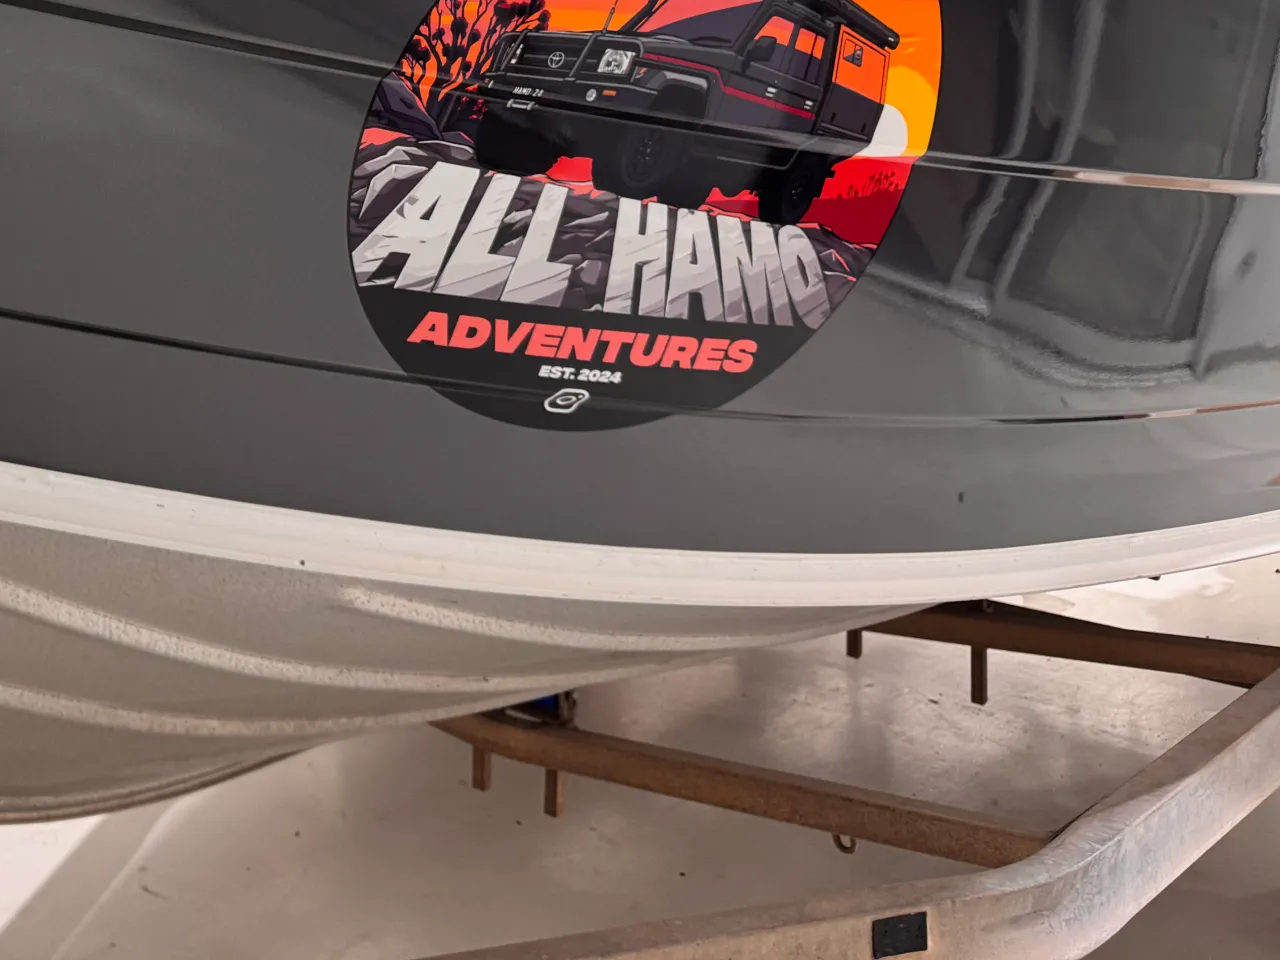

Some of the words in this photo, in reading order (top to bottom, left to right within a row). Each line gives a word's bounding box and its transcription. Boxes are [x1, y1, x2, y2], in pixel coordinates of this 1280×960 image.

[352, 161, 577, 308] ALL
[603, 197, 832, 330] HAMO
[406, 311, 758, 373] ADVENTURES
[538, 365, 576, 381] EST.
[577, 369, 623, 385] 2024
